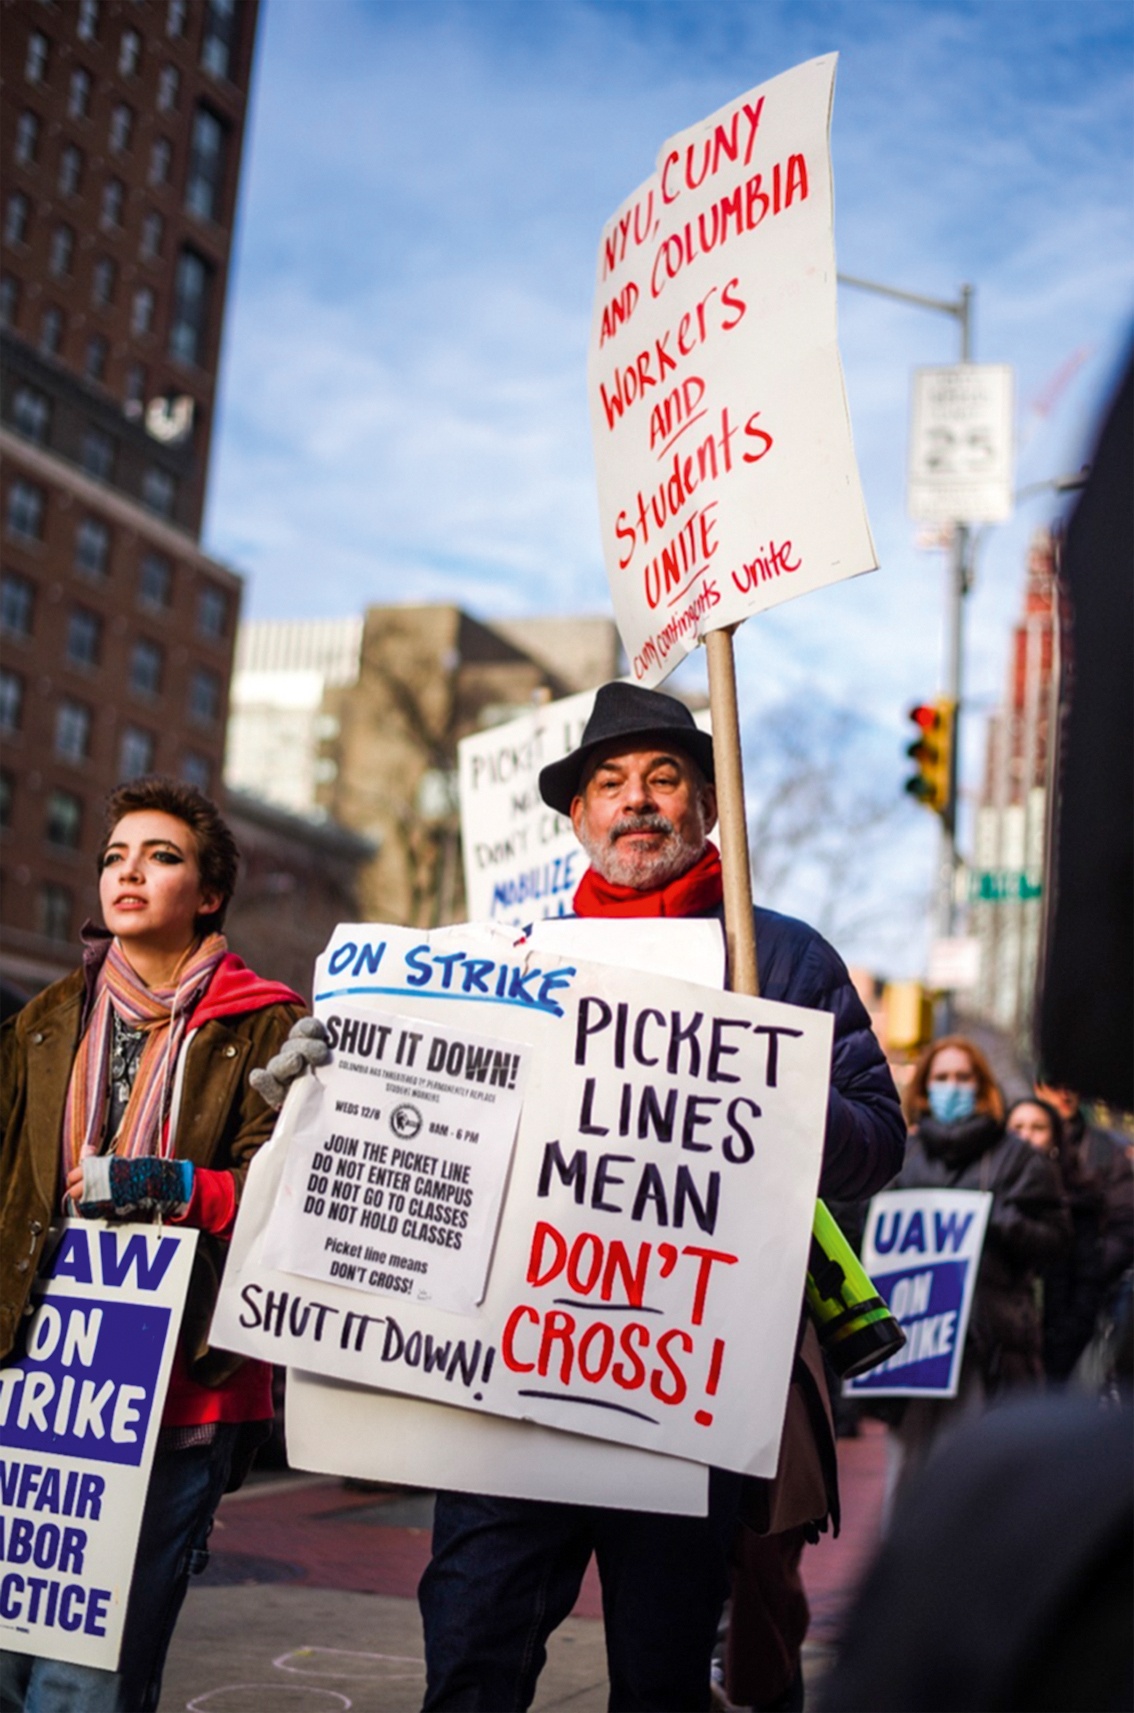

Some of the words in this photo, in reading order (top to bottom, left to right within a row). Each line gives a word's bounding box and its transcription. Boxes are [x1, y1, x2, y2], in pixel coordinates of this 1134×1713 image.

[603, 190, 660, 282] NYU,
[661, 96, 765, 204] CUNY
[599, 282, 639, 349] AND
[652, 153, 807, 298] COLUMBIA
[651, 376, 705, 450] AND
[643, 501, 719, 609] UNITE
[328, 941, 387, 977] ON
[404, 945, 577, 1006] STRIKE
[327, 1015, 392, 1060] SHUT
[395, 1030, 423, 1067] IT
[427, 1037, 521, 1090] DOWN!
[574, 996, 804, 1088] PICKET
[335, 1100, 360, 1116] WEDS
[360, 1106, 381, 1120] 12/8
[429, 1122, 449, 1136] 8AM
[456, 1128, 463, 1140] 6
[464, 1130, 479, 1144] PM
[578, 1078, 762, 1164] LINES
[311, 1151, 333, 1173] DO
[335, 1158, 365, 1181] NOT
[367, 1165, 411, 1192] ENTER
[414, 1176, 473, 1208] CAMPUS
[324, 1134, 359, 1157] JOIN
[362, 1141, 388, 1164] THE
[391, 1148, 439, 1176] PICKET
[440, 1160, 471, 1184] LINE
[537, 1140, 720, 1236] MEAN
[303, 1195, 325, 1216] DO
[328, 1201, 358, 1224] NOT
[360, 1209, 398, 1234] HOLD
[401, 1218, 462, 1250] CLASSES
[307, 1173, 328, 1195] DO
[331, 1180, 361, 1202] NOT
[363, 1187, 384, 1208] GO
[388, 1192, 405, 1213] TO
[408, 1197, 469, 1229] CLASSES
[874, 1209, 976, 1255] UAW
[44, 1228, 181, 1291] AW
[324, 1237, 363, 1259] Picket
[363, 1246, 387, 1264] line
[388, 1254, 428, 1274] means
[329, 1260, 367, 1283] DON'T
[369, 1270, 414, 1295] CROSS!
[526, 1221, 739, 1325] DON'T
[891, 1270, 934, 1321] ON
[27, 1303, 103, 1367] ON
[239, 1284, 339, 1342] SHUT
[340, 1311, 385, 1351] IT
[381, 1315, 496, 1400] DOWN!
[502, 1305, 725, 1426] CROSS!
[854, 1310, 957, 1384] RIKE
[0, 1367, 146, 1444] TRIKE
[0, 1460, 105, 1521] NFAIR
[0, 1515, 88, 1575] BOR
[0, 1572, 112, 1637] CTICE
